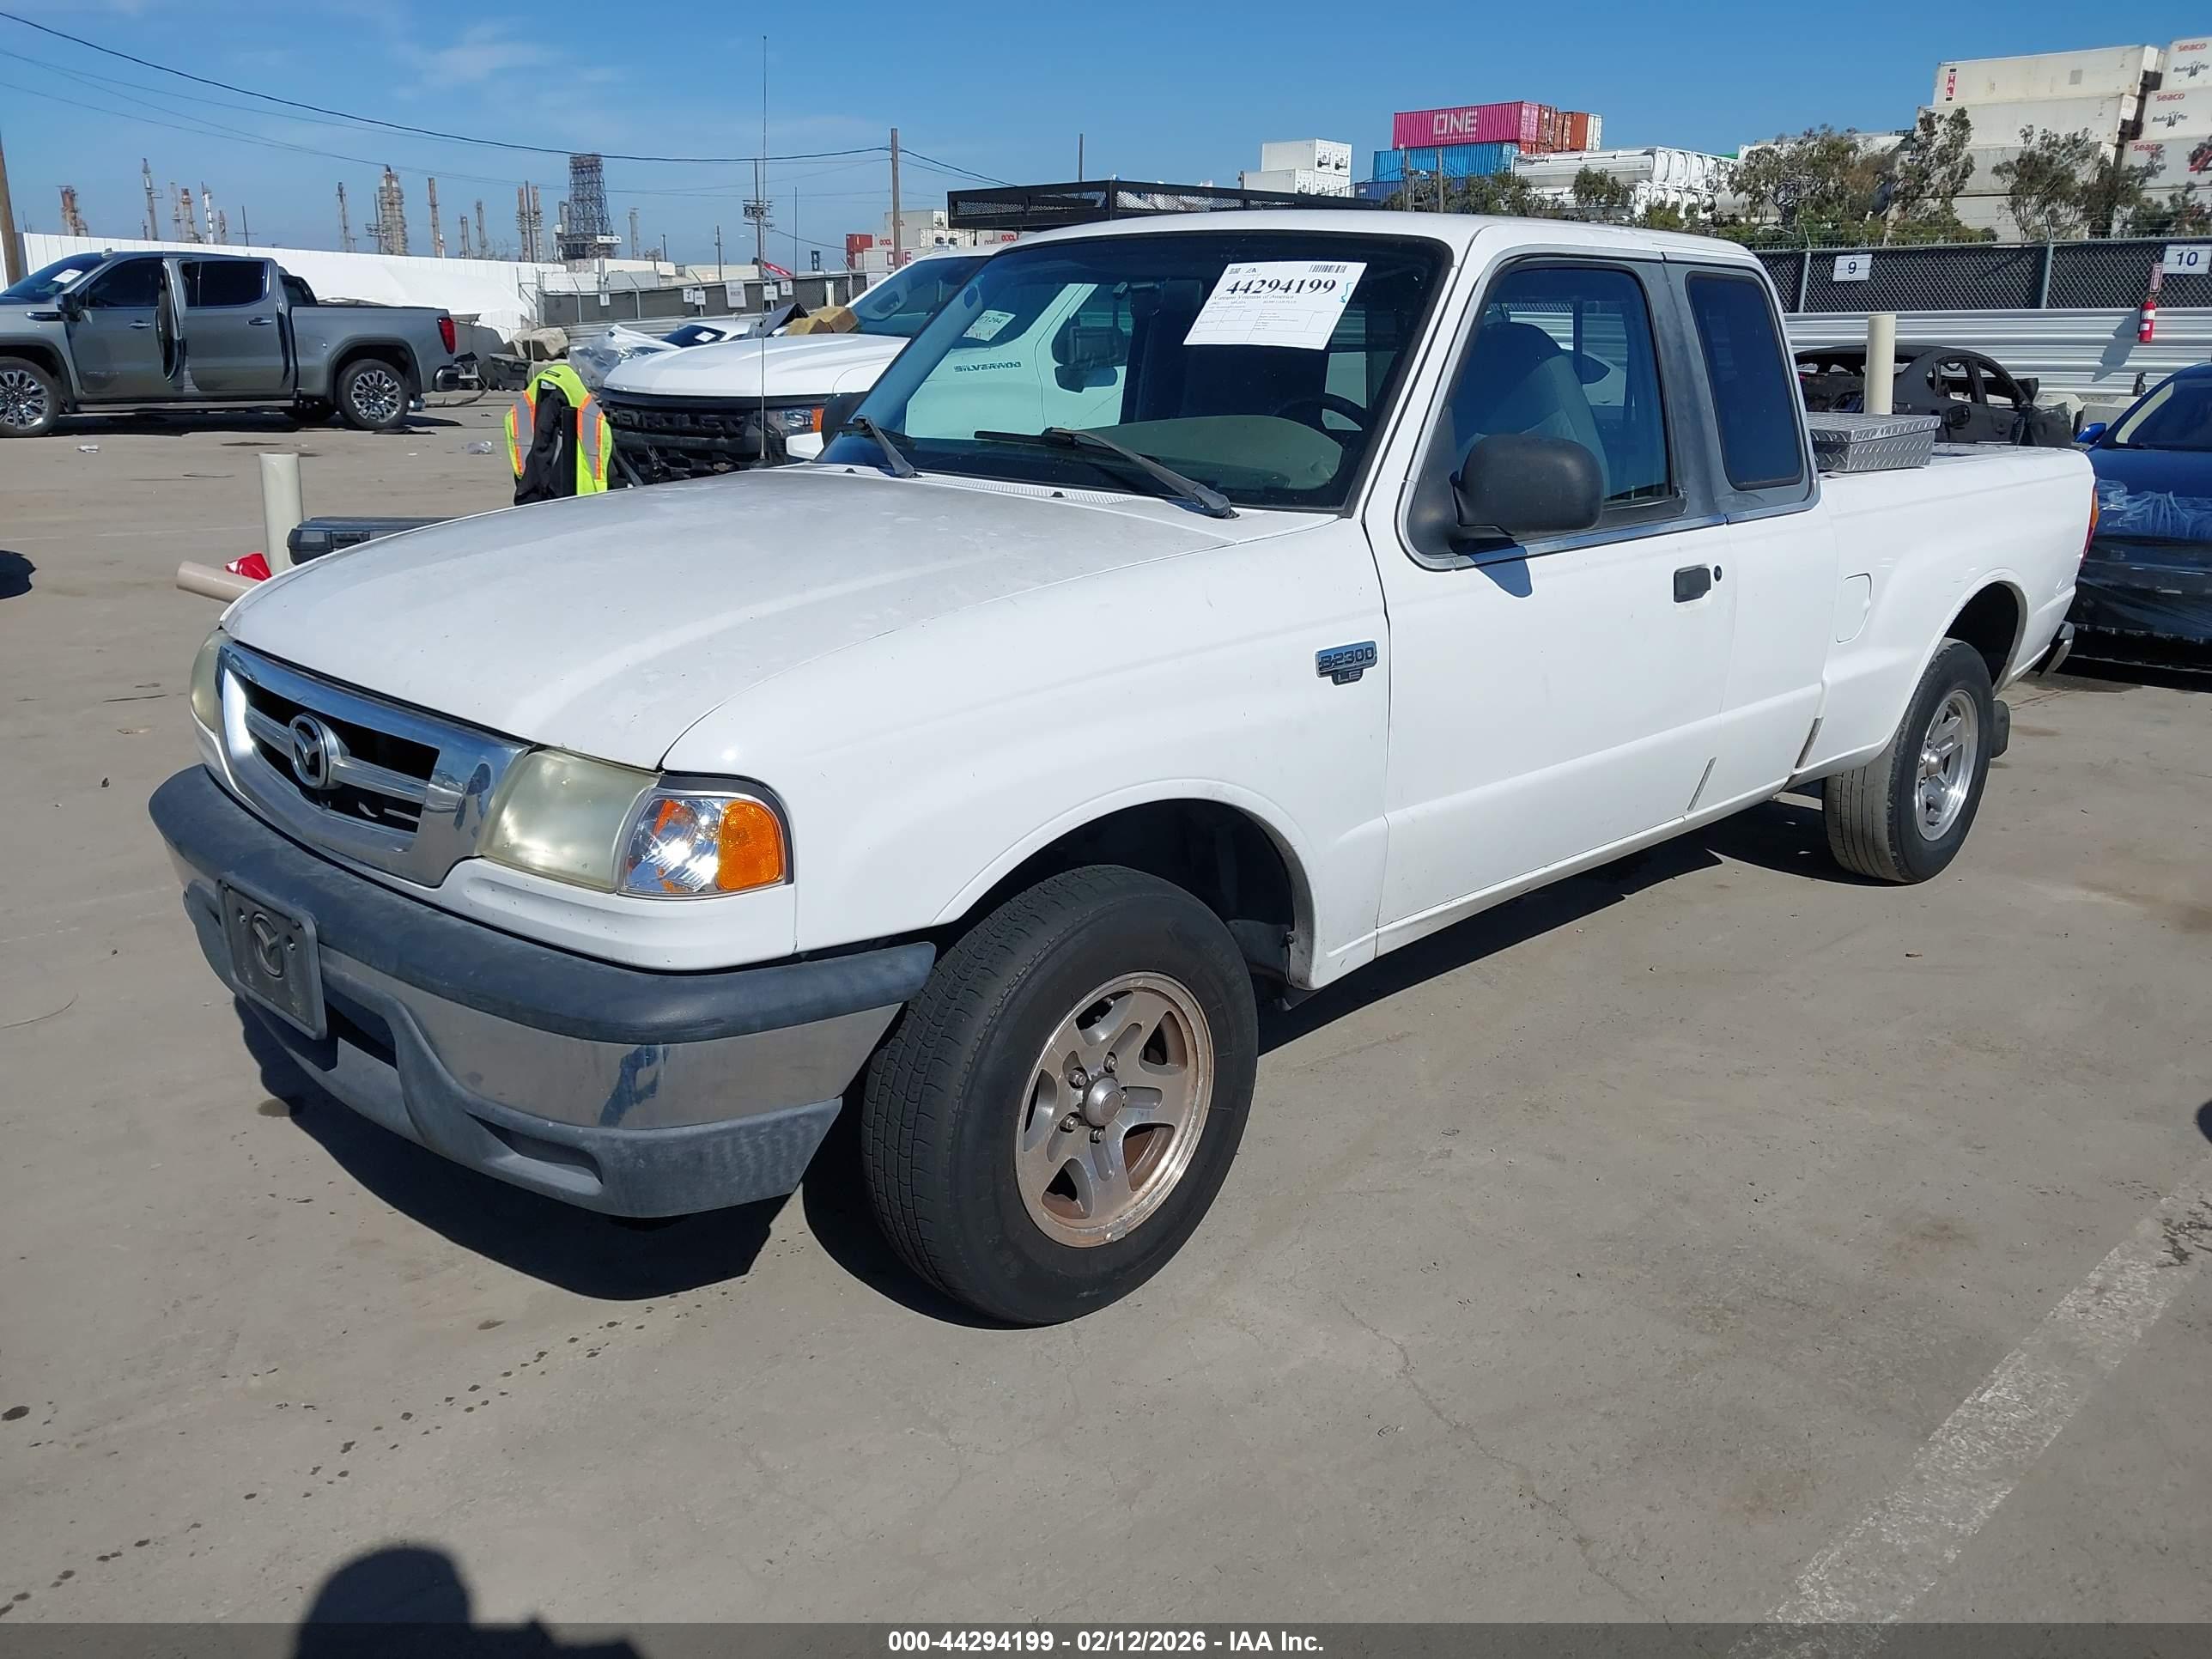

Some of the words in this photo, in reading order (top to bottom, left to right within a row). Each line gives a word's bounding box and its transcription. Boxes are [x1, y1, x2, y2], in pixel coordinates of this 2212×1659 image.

[2156, 93, 2185, 102] seaco
[1432, 110, 1478, 135] ONE
[2175, 251, 2200, 267] 10
[1847, 261, 1857, 275] 9
[1225, 278, 1337, 295] 44294199
[953, 362, 1022, 372] SILVERADO
[1319, 647, 1374, 668] B2300
